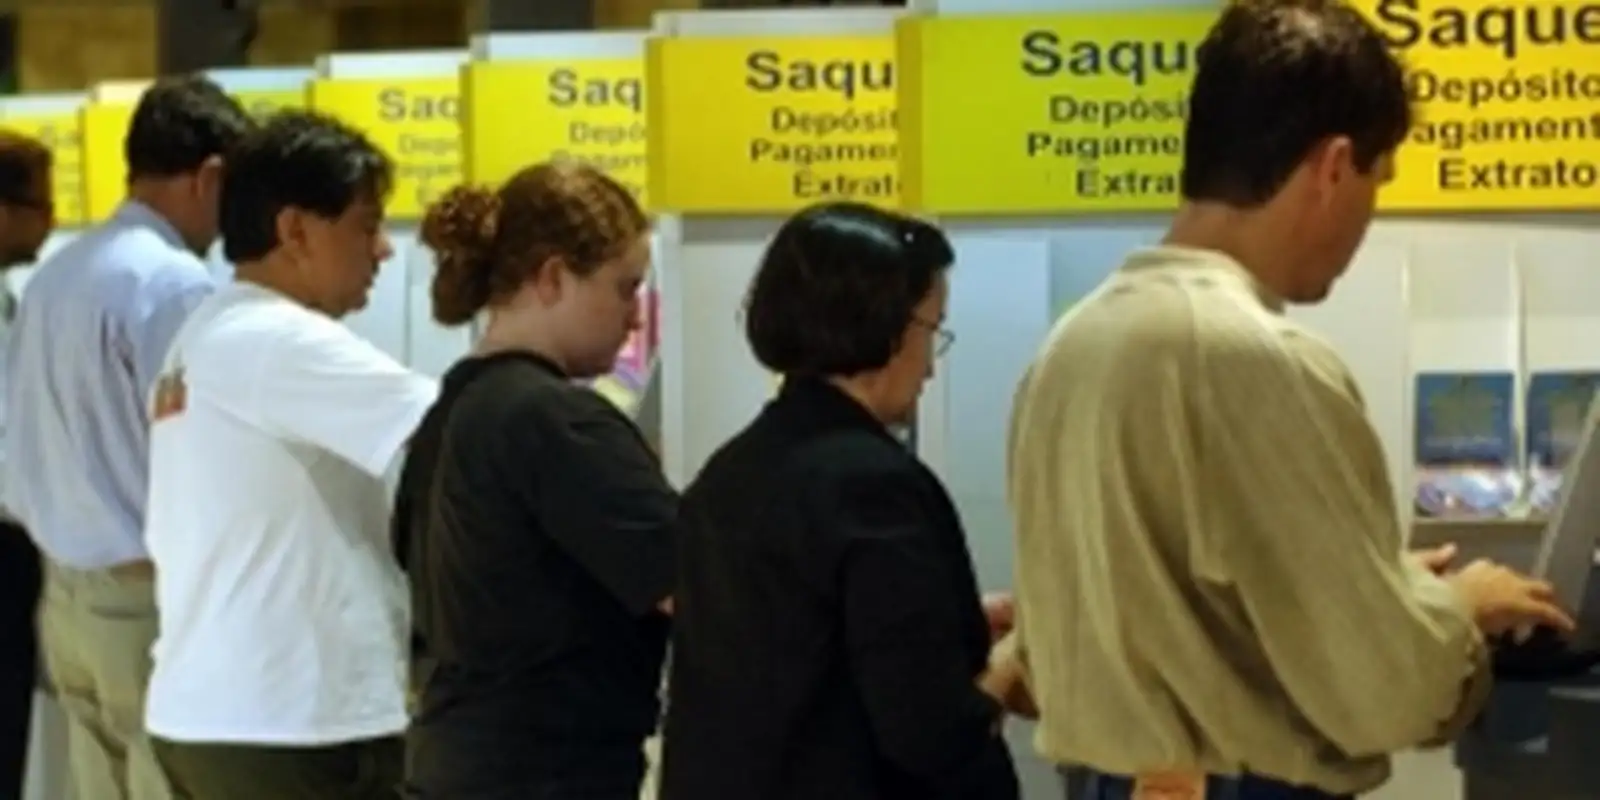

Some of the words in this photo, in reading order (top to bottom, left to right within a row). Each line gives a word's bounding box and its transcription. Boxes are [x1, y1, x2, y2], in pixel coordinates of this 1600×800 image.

[1376, 0, 1600, 58] Saque
[1021, 30, 1200, 84] Saqu
[548, 69, 641, 112] Saq
[746, 53, 893, 99] Saqu
[1027, 132, 1180, 159] Pagame
[1412, 114, 1600, 150] agament
[793, 173, 902, 197] Extrat
[1076, 169, 1176, 196] Extra
[1439, 159, 1597, 190] Extrato
